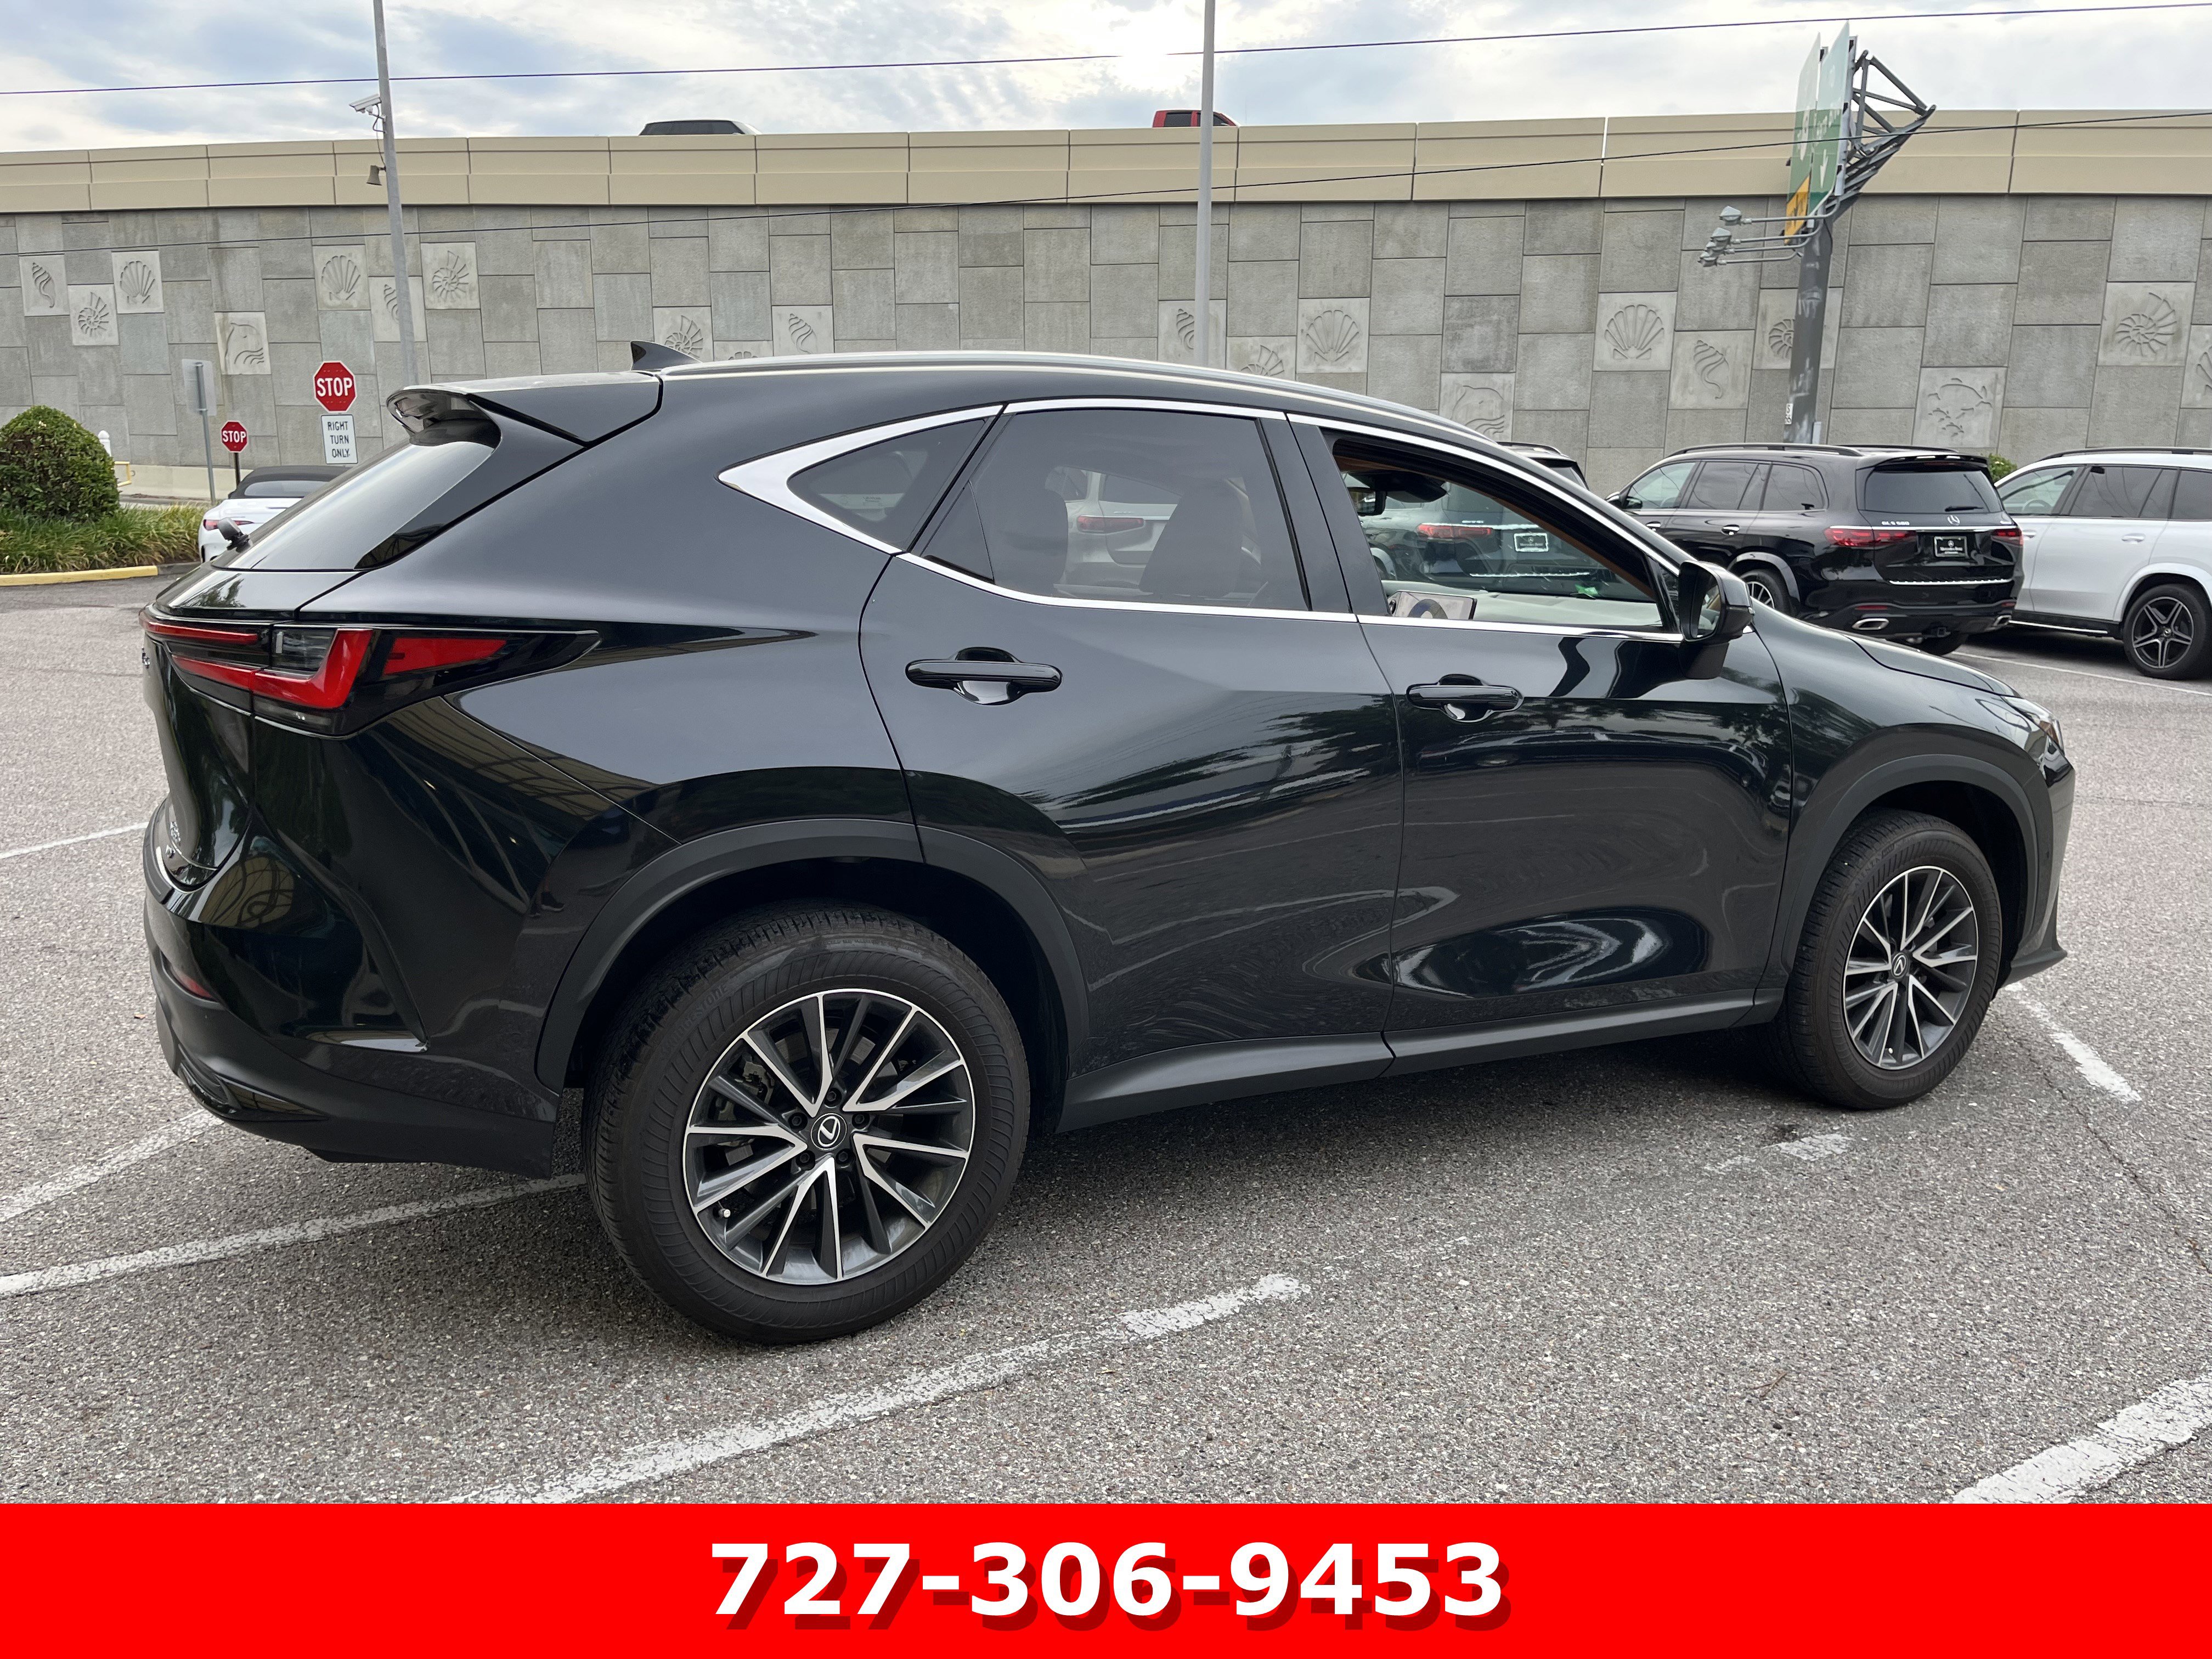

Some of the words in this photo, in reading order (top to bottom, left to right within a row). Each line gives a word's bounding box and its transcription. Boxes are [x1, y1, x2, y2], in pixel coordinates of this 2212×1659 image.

[317, 377, 353, 397] STOP
[328, 421, 348, 431] RIGHT
[222, 430, 246, 443] STOP
[330, 435, 349, 444] TURN
[332, 448, 350, 458] ONLY
